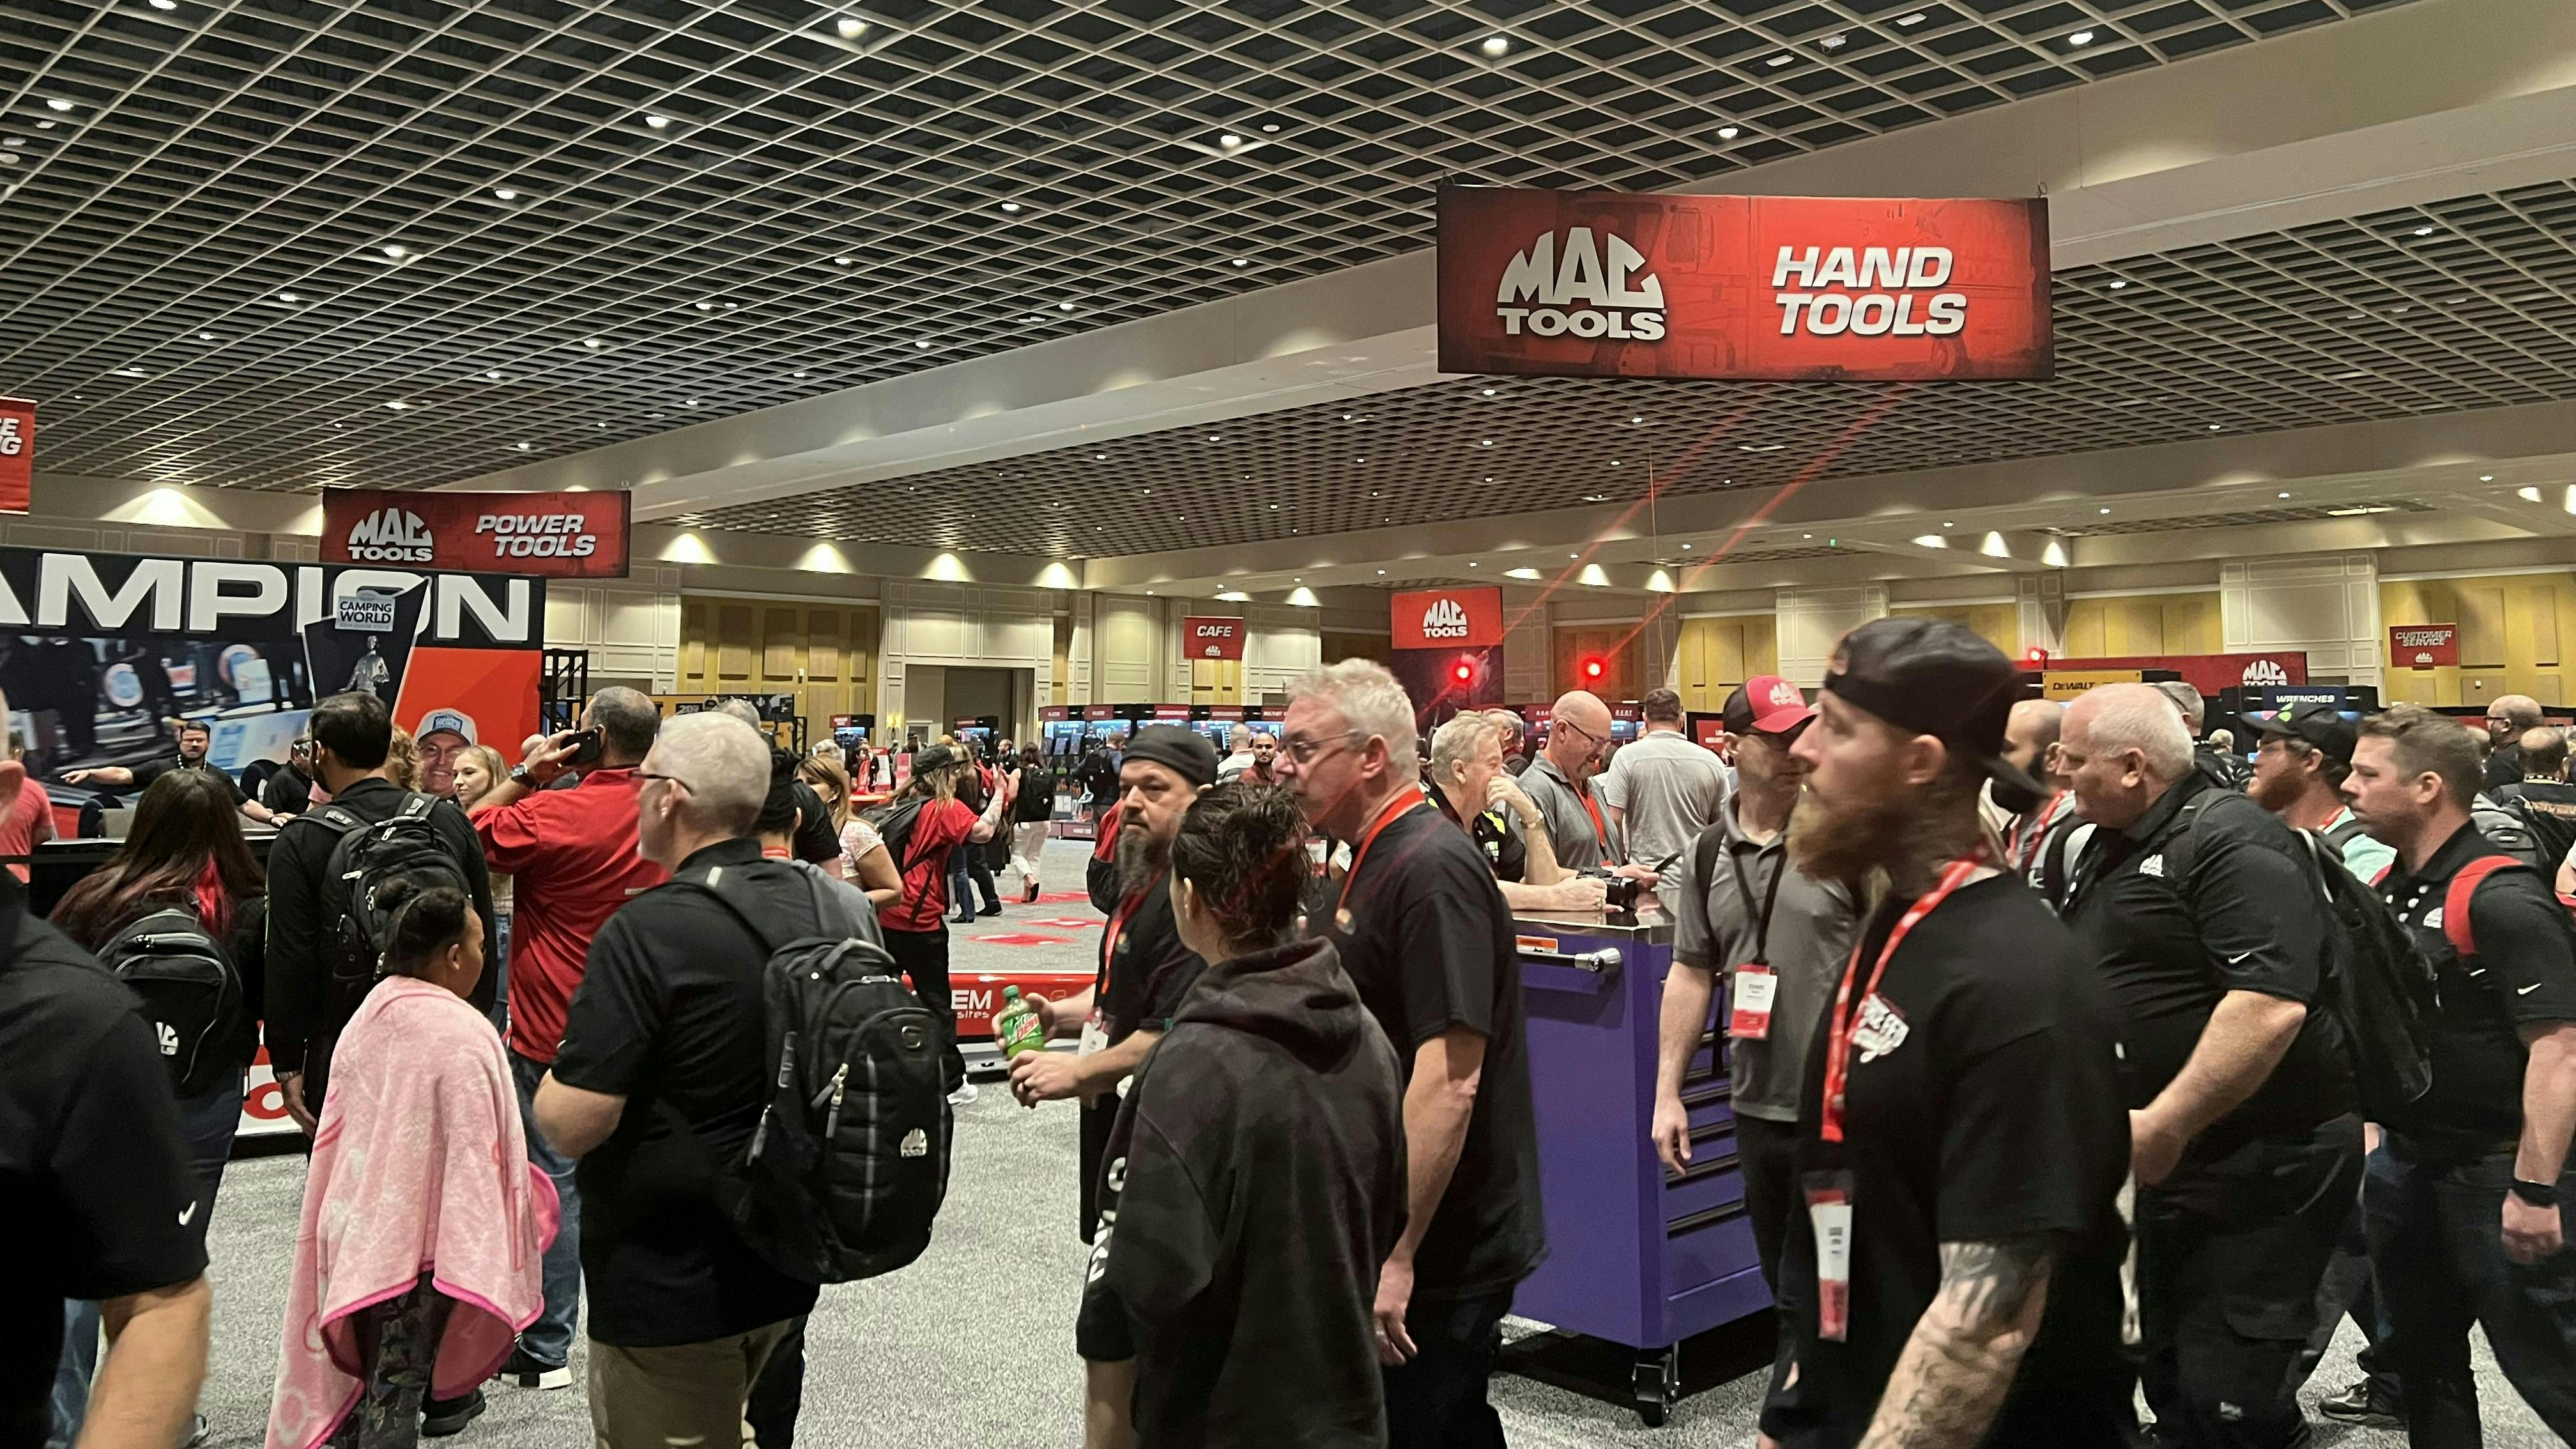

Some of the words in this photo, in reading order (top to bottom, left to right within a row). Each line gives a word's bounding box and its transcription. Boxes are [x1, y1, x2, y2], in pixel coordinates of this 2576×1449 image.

[1498, 227, 1664, 308] MAC
[1772, 246, 1953, 289] HAND
[1498, 307, 1665, 340] TOOLS
[1776, 293, 1967, 335] TOOLS
[349, 508, 432, 546] MAC
[476, 514, 584, 533] POWER
[348, 546, 433, 562] TOOLS
[494, 535, 595, 557] TOOLS
[0, 553, 530, 641] MPION
[340, 601, 392, 612] CAMPING
[340, 611, 391, 624] WORLD
[1423, 599, 1467, 628] MAC
[1197, 625, 1232, 637] CAFE
[1423, 626, 1467, 638] TOOLS
[2396, 631, 2452, 640] CUSTOMER
[2402, 638, 2445, 647] SERVICE
[2242, 660, 2287, 680] MAC
[2276, 695, 2335, 703] WRENCHES
